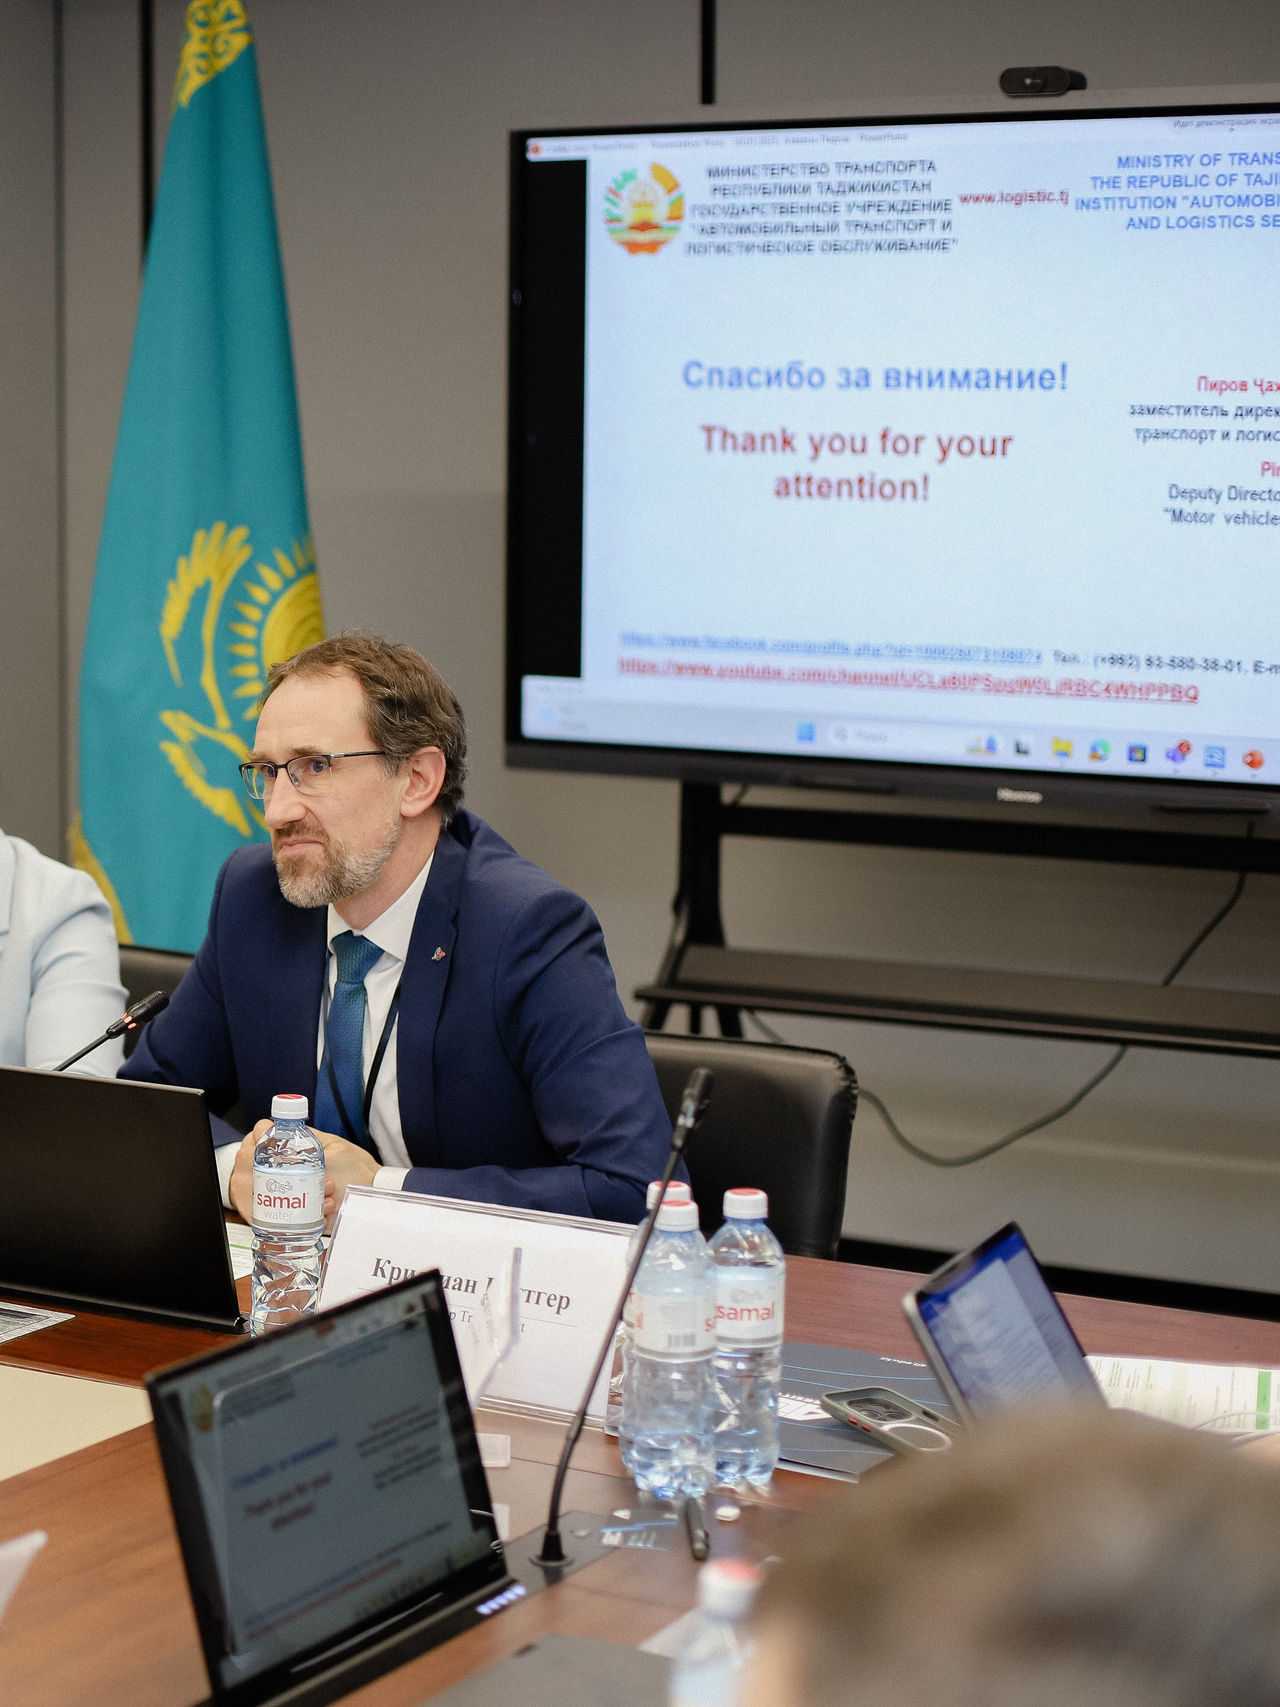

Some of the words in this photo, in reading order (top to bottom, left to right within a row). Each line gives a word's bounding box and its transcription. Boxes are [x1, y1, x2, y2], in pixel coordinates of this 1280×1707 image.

[707, 164, 830, 179] МИНИСТЕРСТВО
[835, 160, 937, 175] ТРАНСПОРТА
[1117, 153, 1194, 169] MINISTRY
[1200, 153, 1222, 167] OF
[711, 182, 812, 198] РЕСПУБЛИКИ
[817, 180, 932, 195] ТАДЖИКИСТАН
[1091, 176, 1121, 190] THE
[1127, 174, 1210, 189] REPUBLIC
[1216, 173, 1238, 187] OF
[1244, 172, 1280, 187] TAJI
[958, 189, 1069, 206] www.logistic.tj
[1075, 195, 1177, 210] INSTITUTION
[690, 202, 841, 218] ГОСУДАРСТВЕННОЕ
[845, 199, 953, 215] УЧРЕЖДЕНИЕ
[845, 218, 937, 234] ТРАНСПОРТ
[942, 219, 953, 231] И
[1126, 216, 1161, 230] AND
[1166, 214, 1255, 229] LOGISTICS
[1260, 214, 1280, 228] SE
[686, 240, 815, 256] ЛОГИСТИЧЕСКОЕ
[682, 358, 826, 391] Спасибо
[836, 365, 872, 390] за
[884, 360, 1069, 391] внимание!
[1198, 375, 1248, 396] Пиров
[1129, 404, 1229, 418] заместитель
[701, 424, 797, 455] Thank
[809, 431, 868, 461] you
[879, 426, 924, 456] for
[935, 433, 1015, 464] your
[1134, 427, 1217, 446] транспорт
[1221, 430, 1231, 441] и
[774, 473, 931, 502] attention!
[1168, 483, 1222, 504] Deputy
[256, 1193, 306, 1209] samal
[264, 1211, 293, 1220] water
[371, 1257, 479, 1294] Крииан
[715, 1302, 775, 1321] samal
